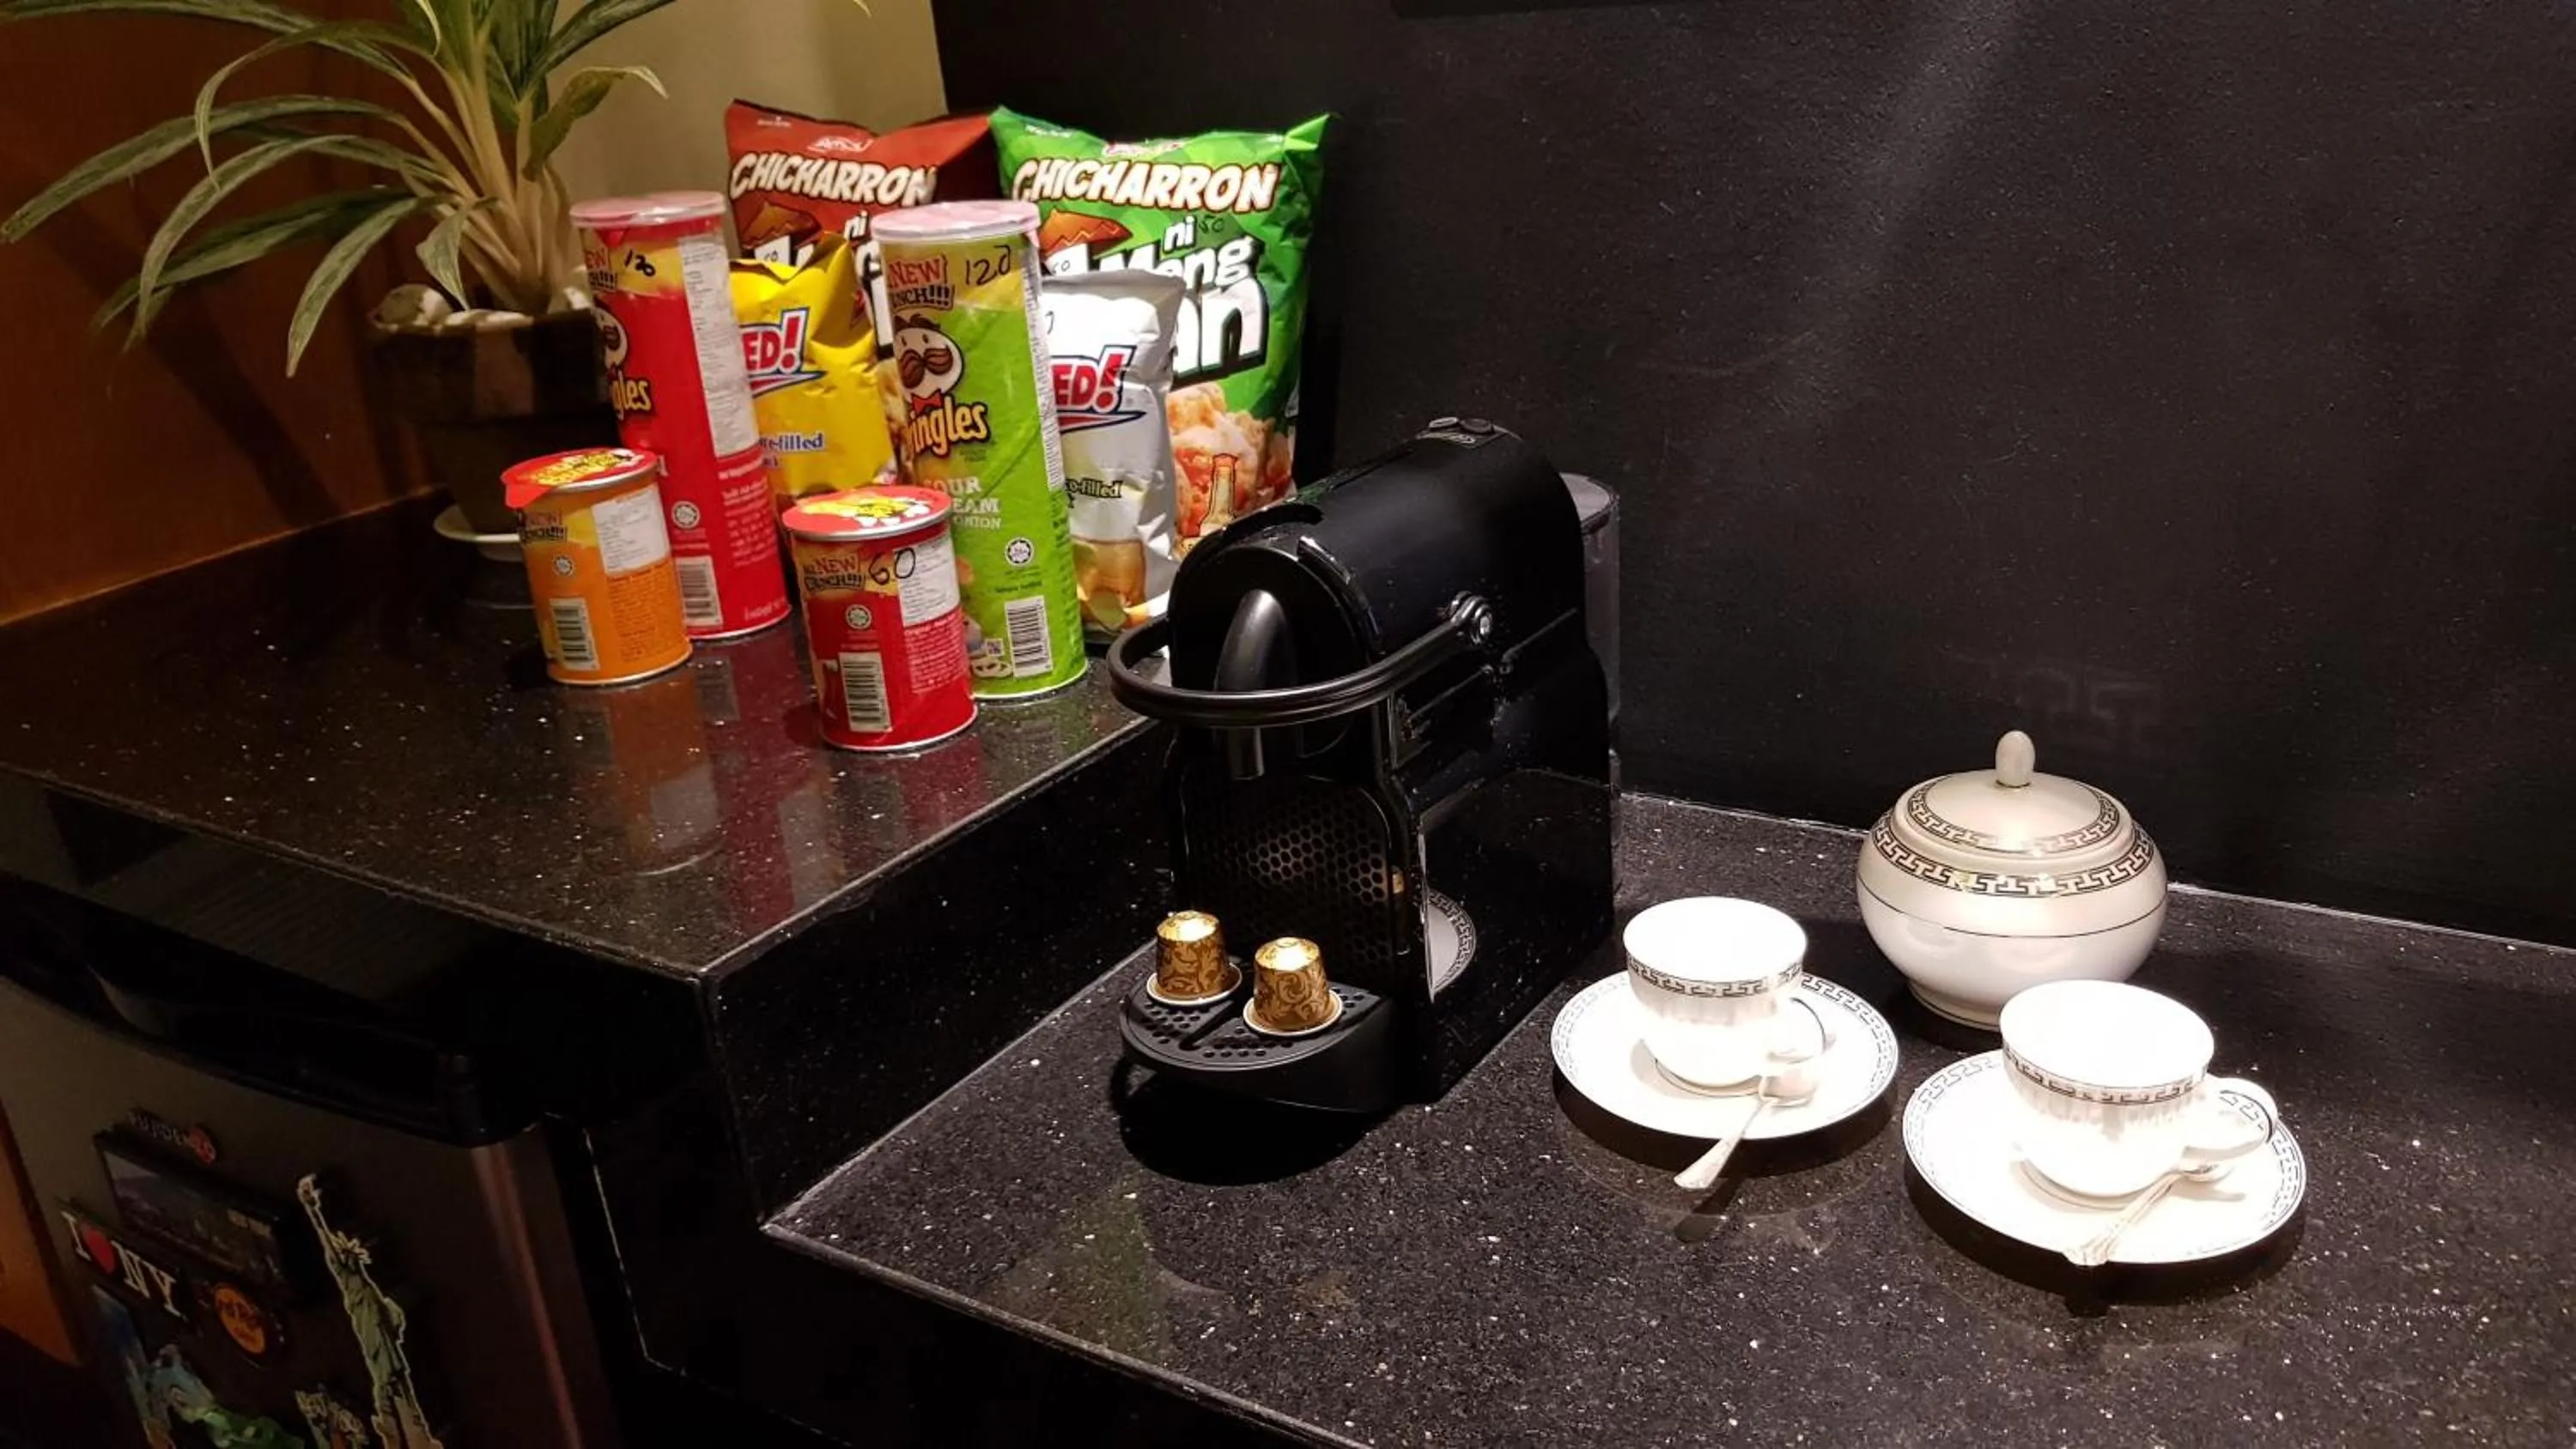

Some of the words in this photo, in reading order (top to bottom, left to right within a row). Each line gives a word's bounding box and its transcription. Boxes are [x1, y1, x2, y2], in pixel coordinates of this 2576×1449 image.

[730, 152, 937, 207] CHICHARRON
[1012, 158, 1278, 211] CHICHARRON
[1163, 215, 1195, 255] ni
[889, 258, 940, 288] NEW
[965, 245, 1011, 286] 120
[923, 475, 982, 497] OUR
[952, 497, 1000, 513] EAM
[868, 548, 916, 585] 60
[111, 1240, 185, 1320] NY
